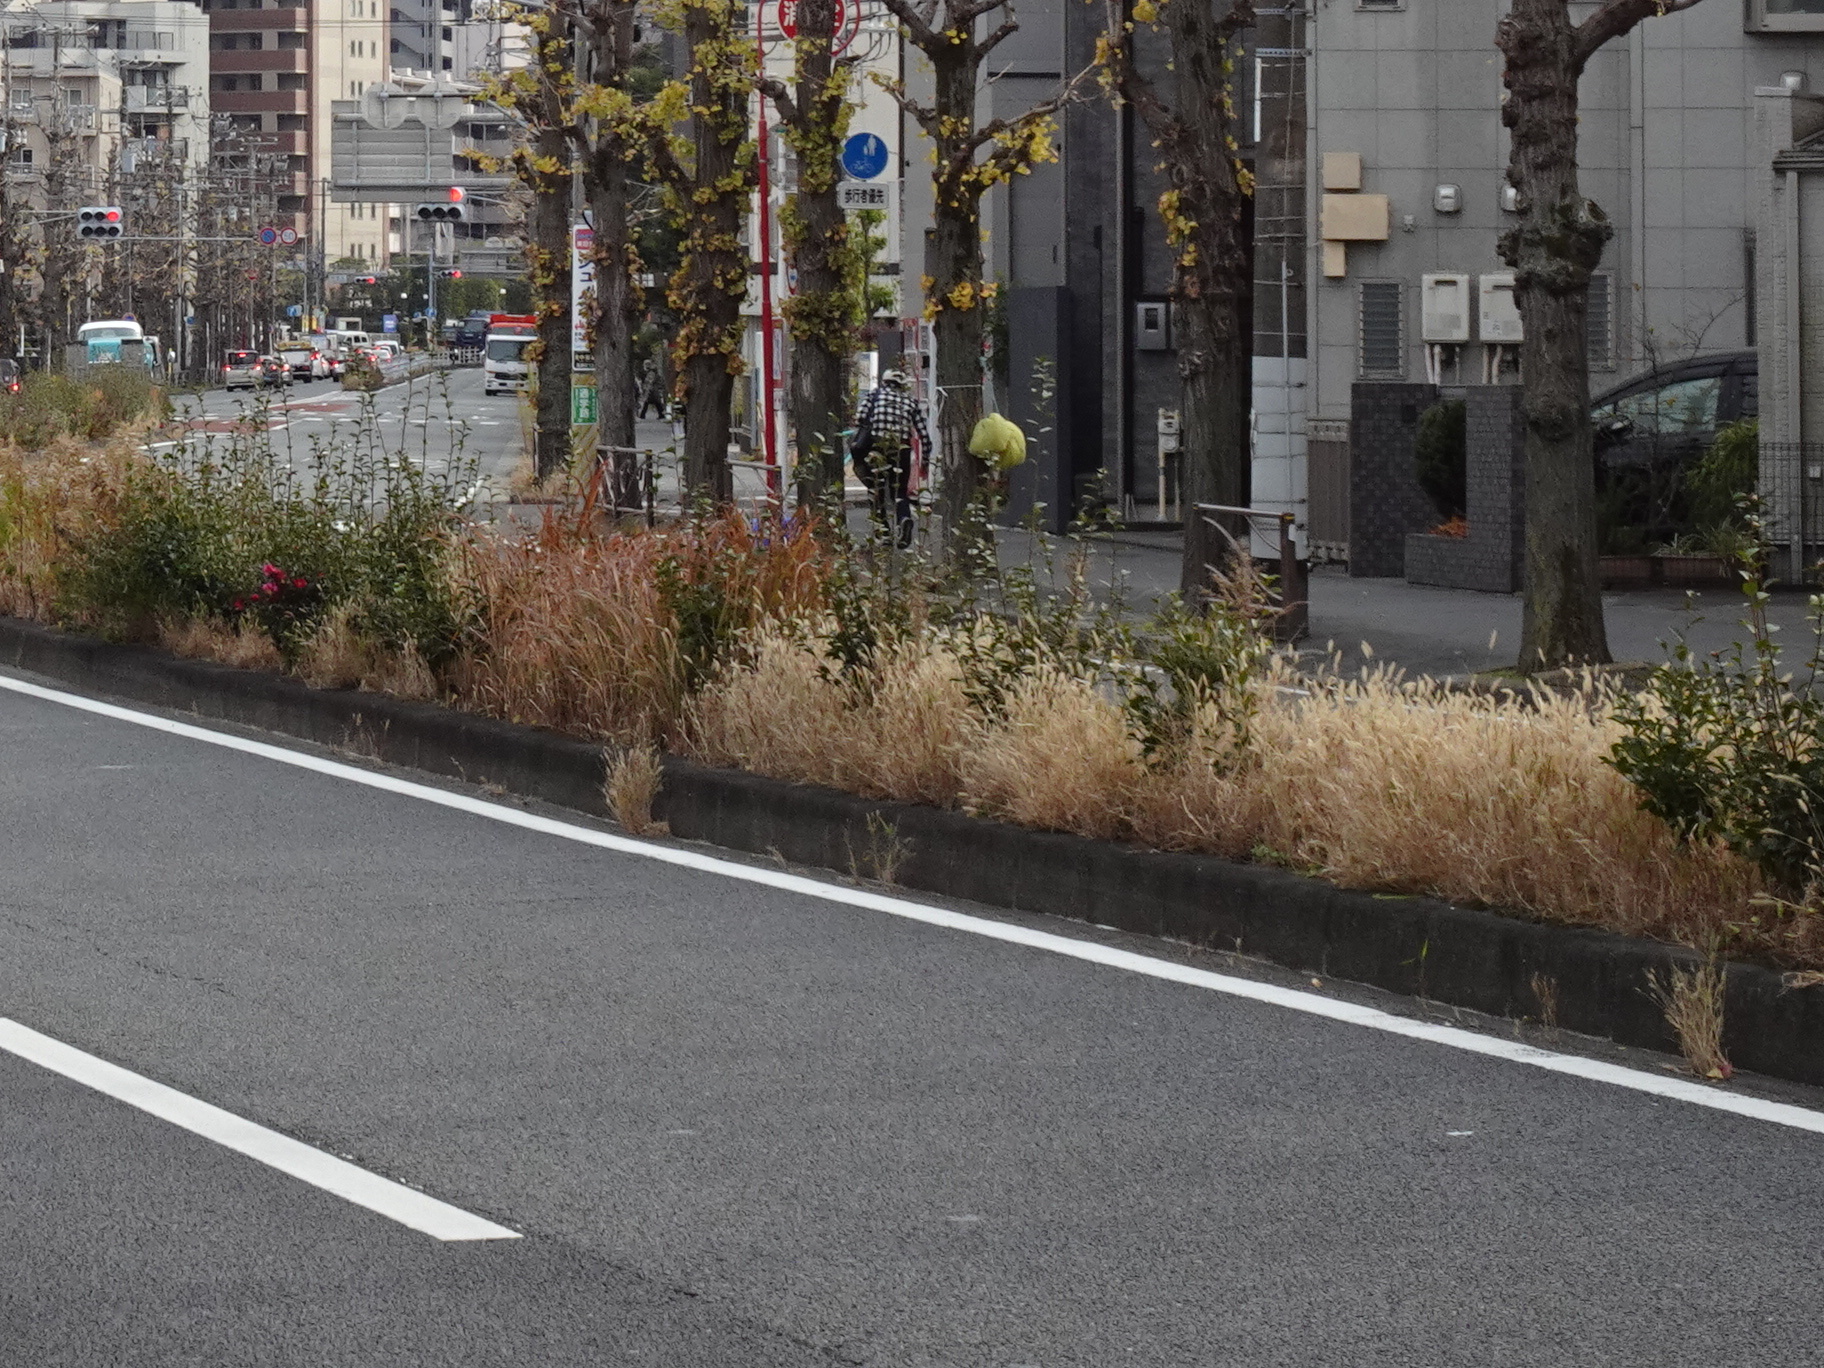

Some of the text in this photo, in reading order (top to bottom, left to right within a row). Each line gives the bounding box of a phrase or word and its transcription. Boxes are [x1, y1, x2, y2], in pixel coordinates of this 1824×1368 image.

[845, 188, 885, 203] 歩行者優先
